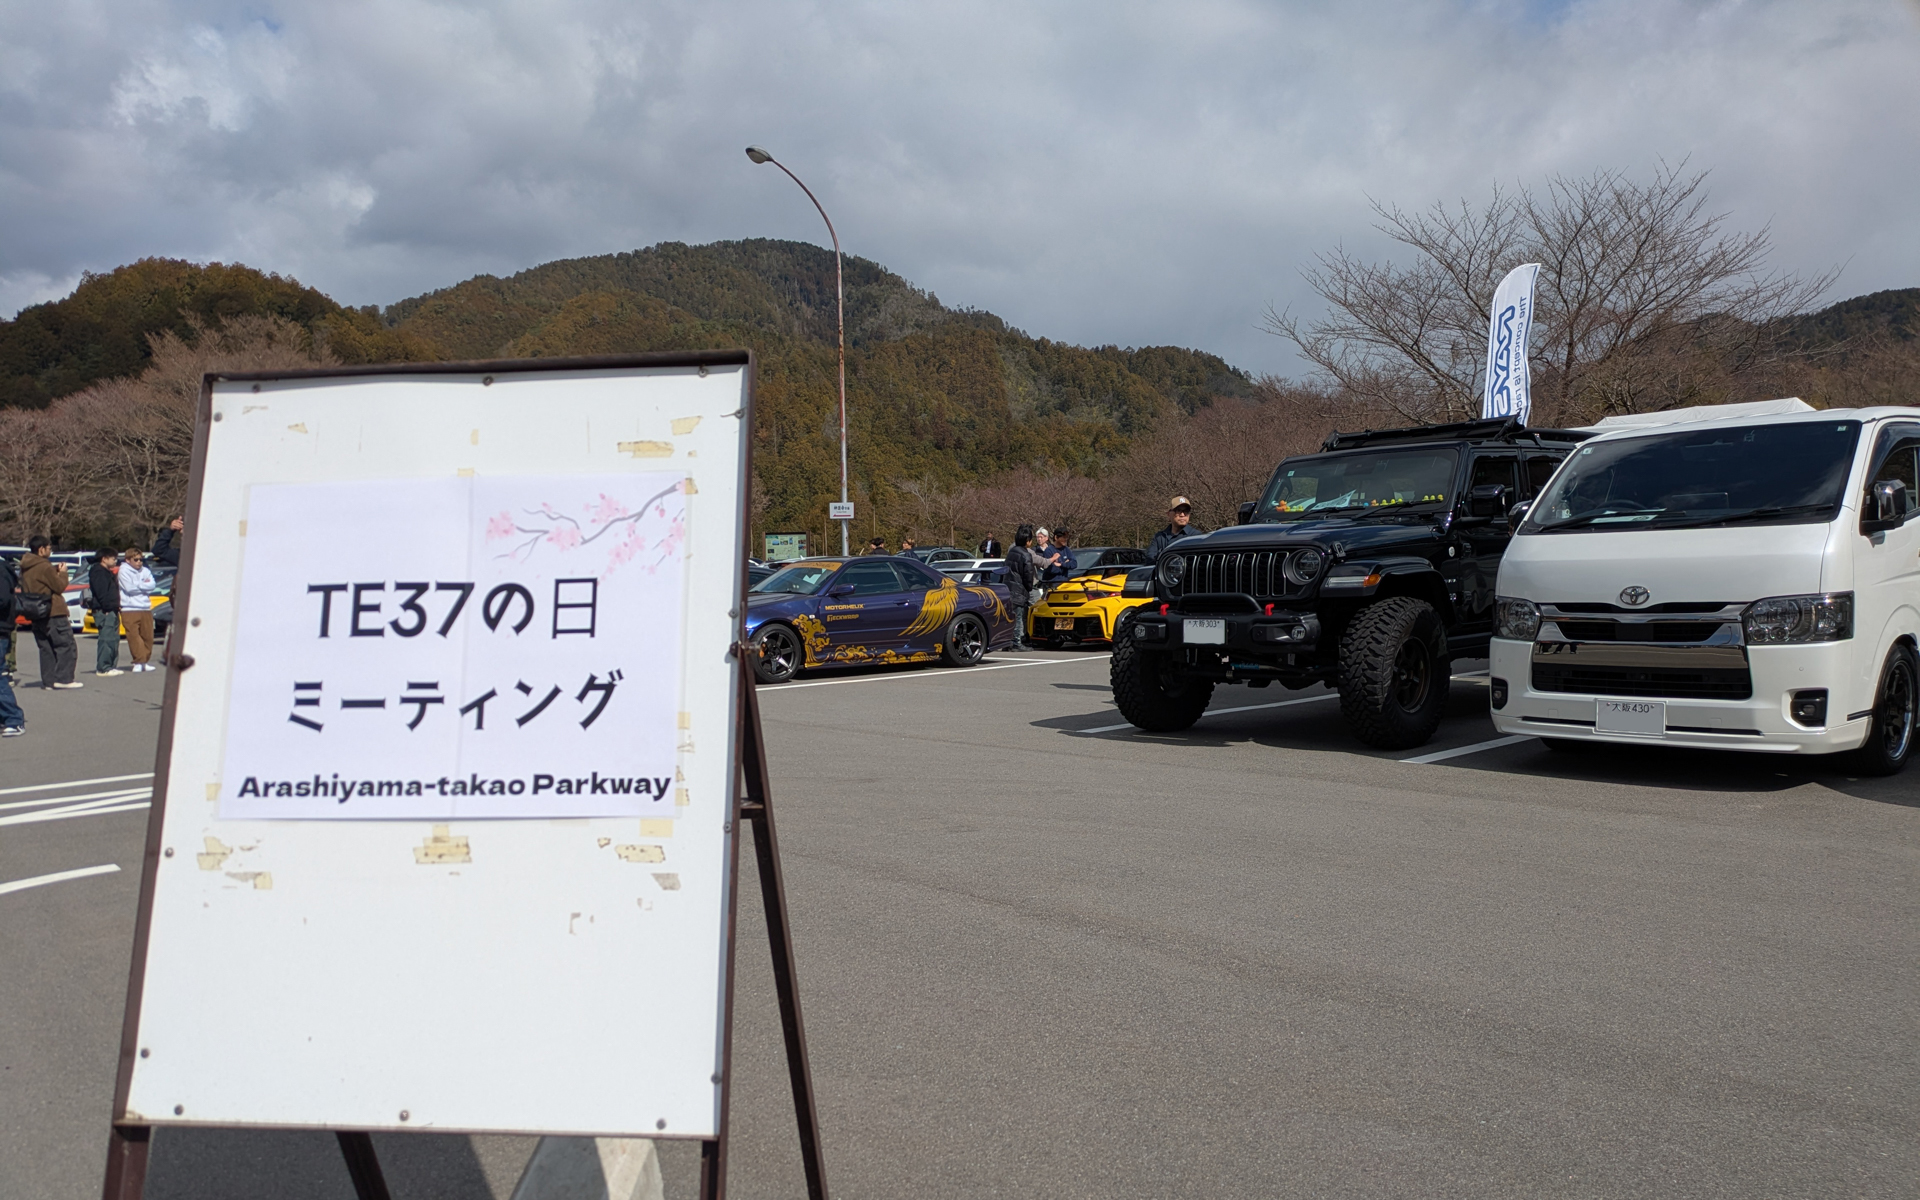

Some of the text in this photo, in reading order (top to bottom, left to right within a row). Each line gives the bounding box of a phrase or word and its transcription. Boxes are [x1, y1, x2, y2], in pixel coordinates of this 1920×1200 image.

[307, 577, 598, 639] TE37の日
[288, 669, 624, 733] ミーティング
[1612, 702, 1650, 713] 大阪430
[238, 771, 671, 804] Arashiyama-takao Parkway
